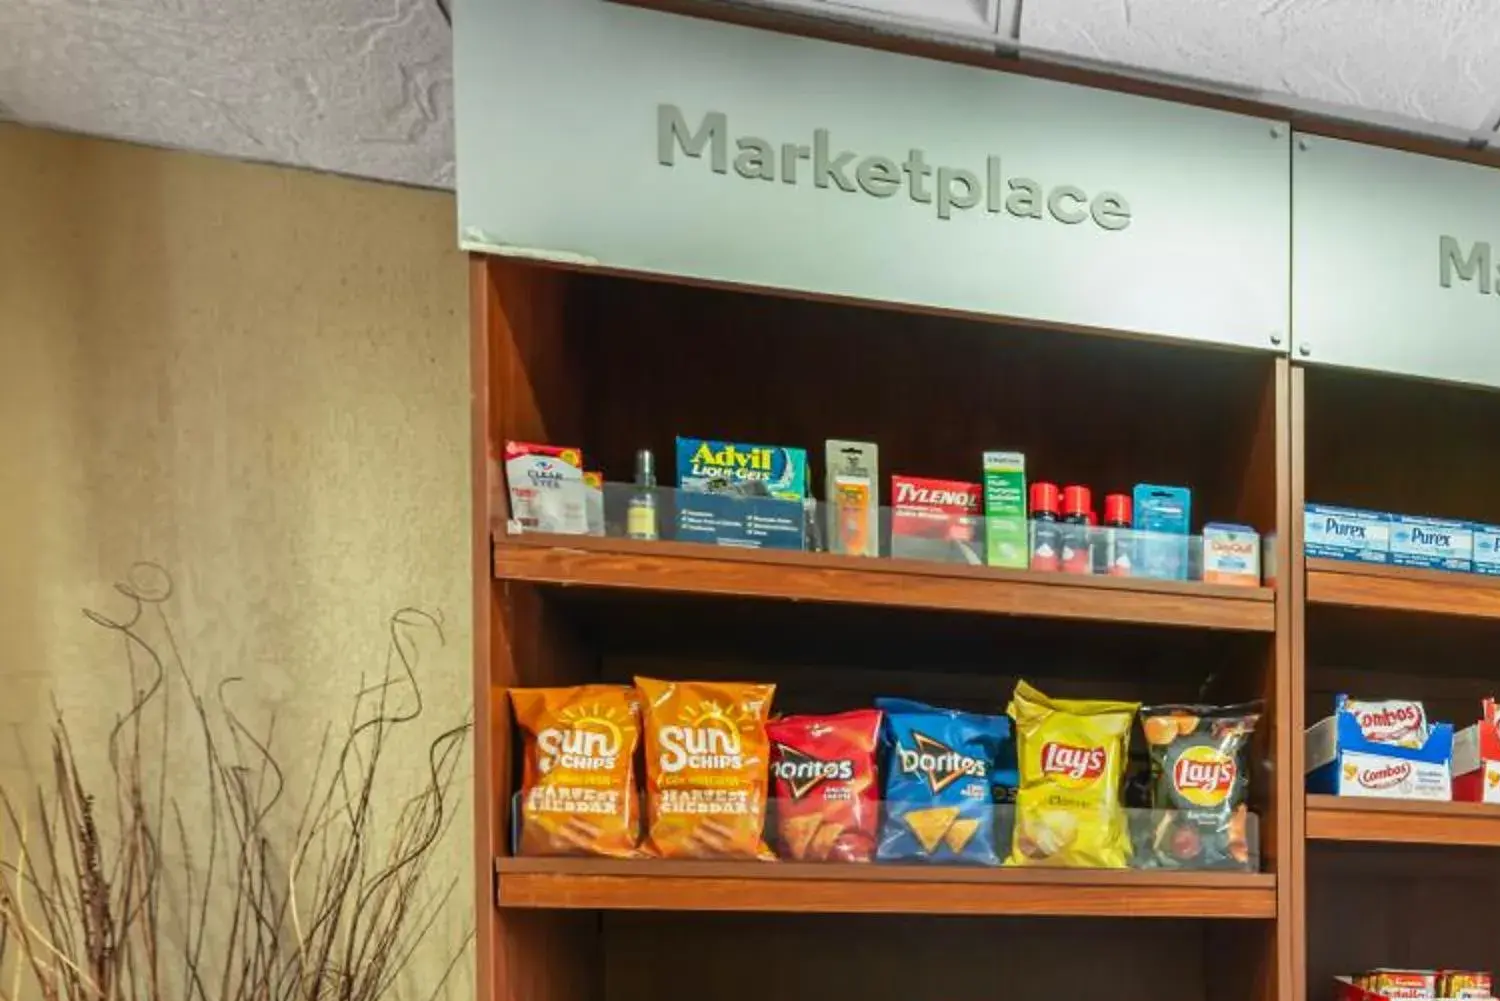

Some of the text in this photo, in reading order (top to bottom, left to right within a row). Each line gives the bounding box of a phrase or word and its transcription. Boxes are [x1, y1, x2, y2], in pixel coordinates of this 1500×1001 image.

[656, 103, 1132, 231] Marketplace
[689, 441, 772, 470] Advil
[896, 483, 977, 507] TYLENOL
[1326, 518, 1367, 539] Purex
[1411, 527, 1451, 547] Purex
[561, 754, 616, 770] CHIPS
[687, 754, 742, 770] CHIPS
[902, 749, 986, 777] Doritos
[1044, 743, 1105, 779] Lay's
[1362, 763, 1408, 781] Combos
[1179, 759, 1232, 793] Lay's
